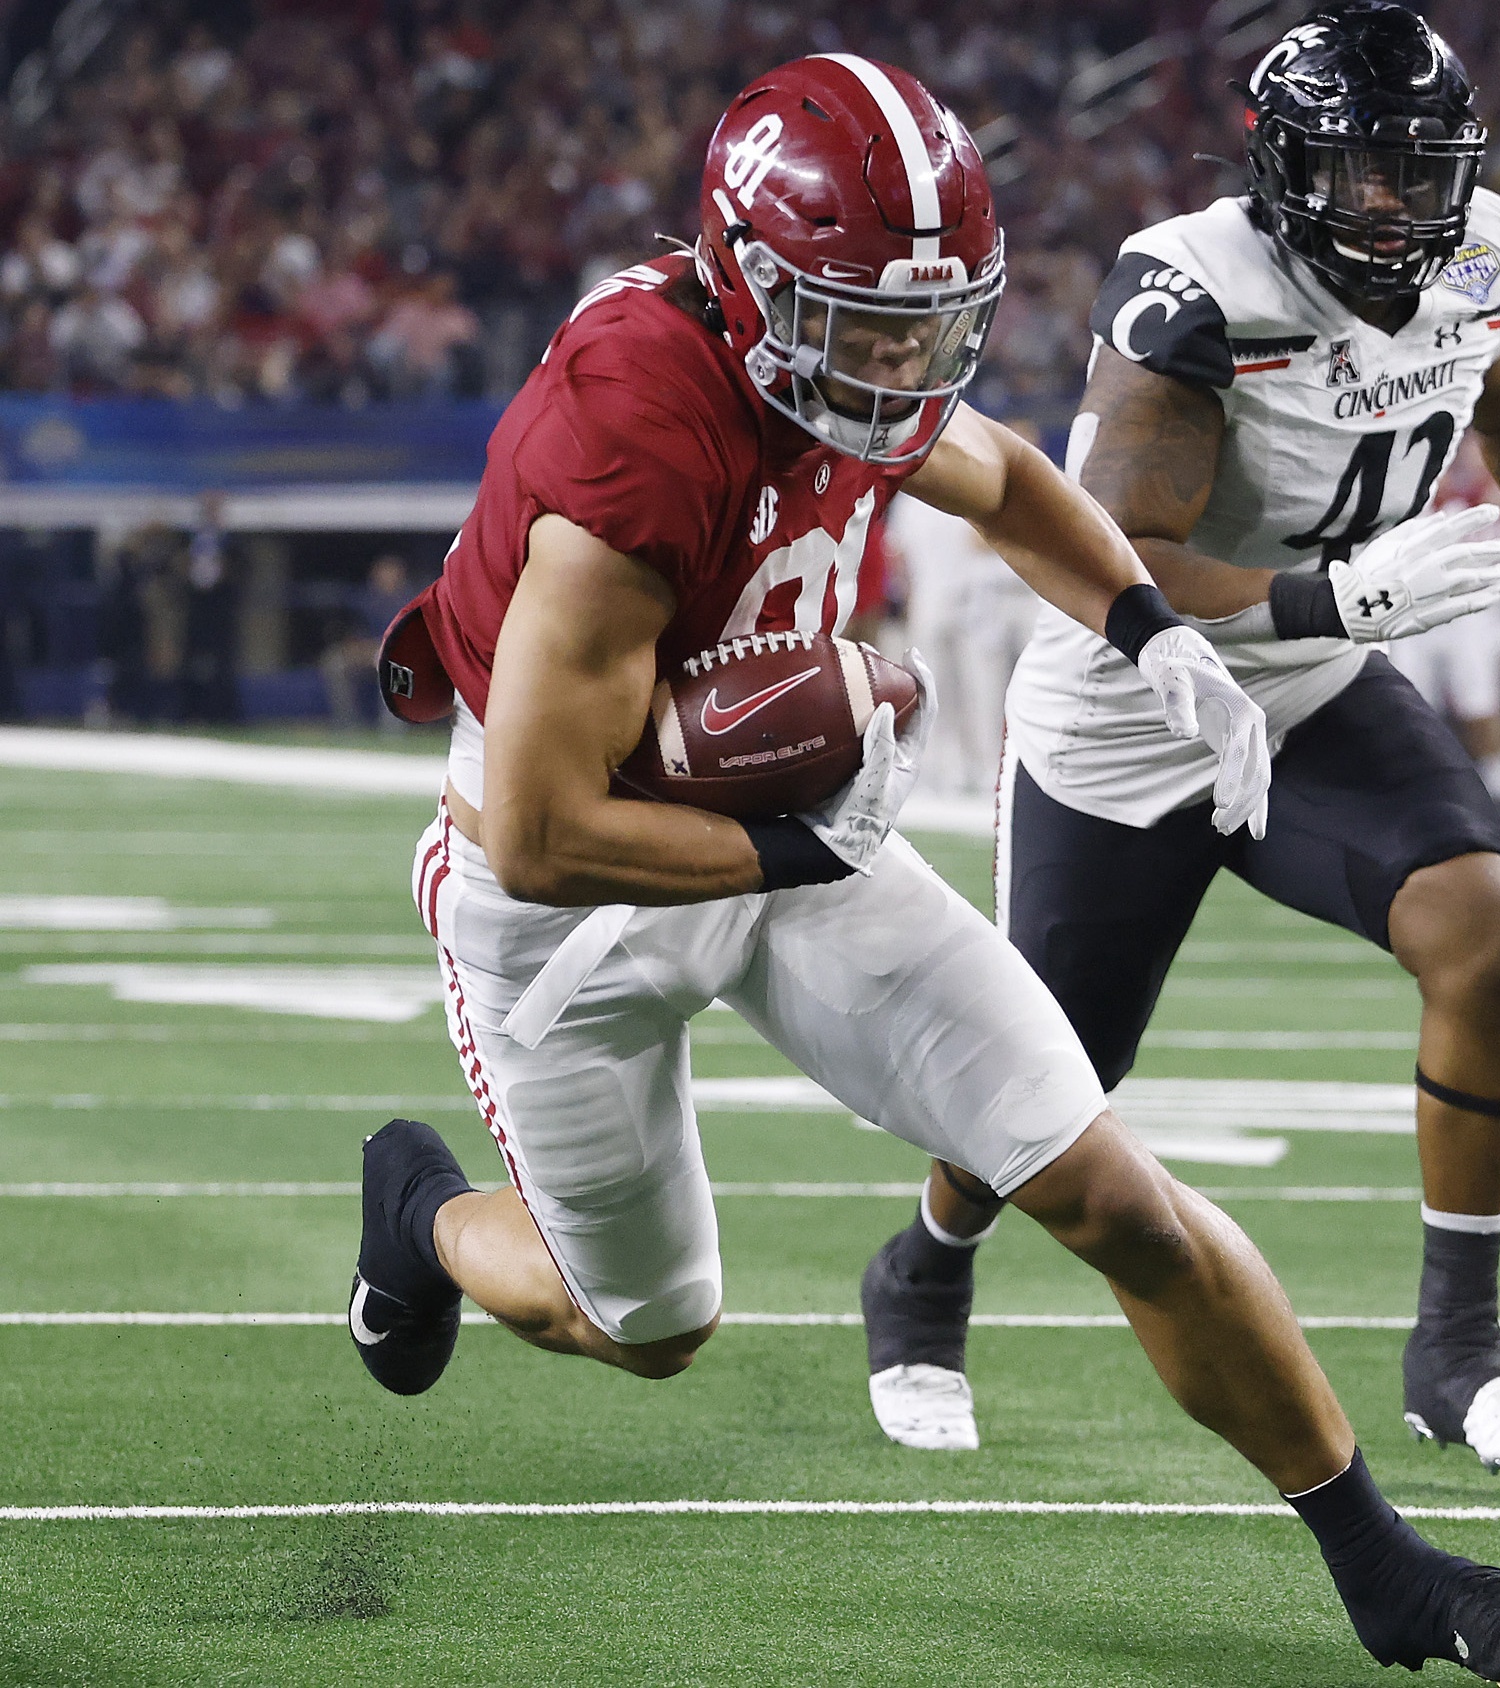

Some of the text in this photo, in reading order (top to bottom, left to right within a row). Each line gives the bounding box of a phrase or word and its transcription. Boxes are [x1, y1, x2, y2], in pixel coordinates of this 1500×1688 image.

[723, 113, 784, 211] 81
[911, 265, 954, 282] BAMA
[1334, 360, 1457, 420] CINCINNATI
[1280, 410, 1455, 573] 42
[719, 734, 826, 769] VAPOR ELITE
